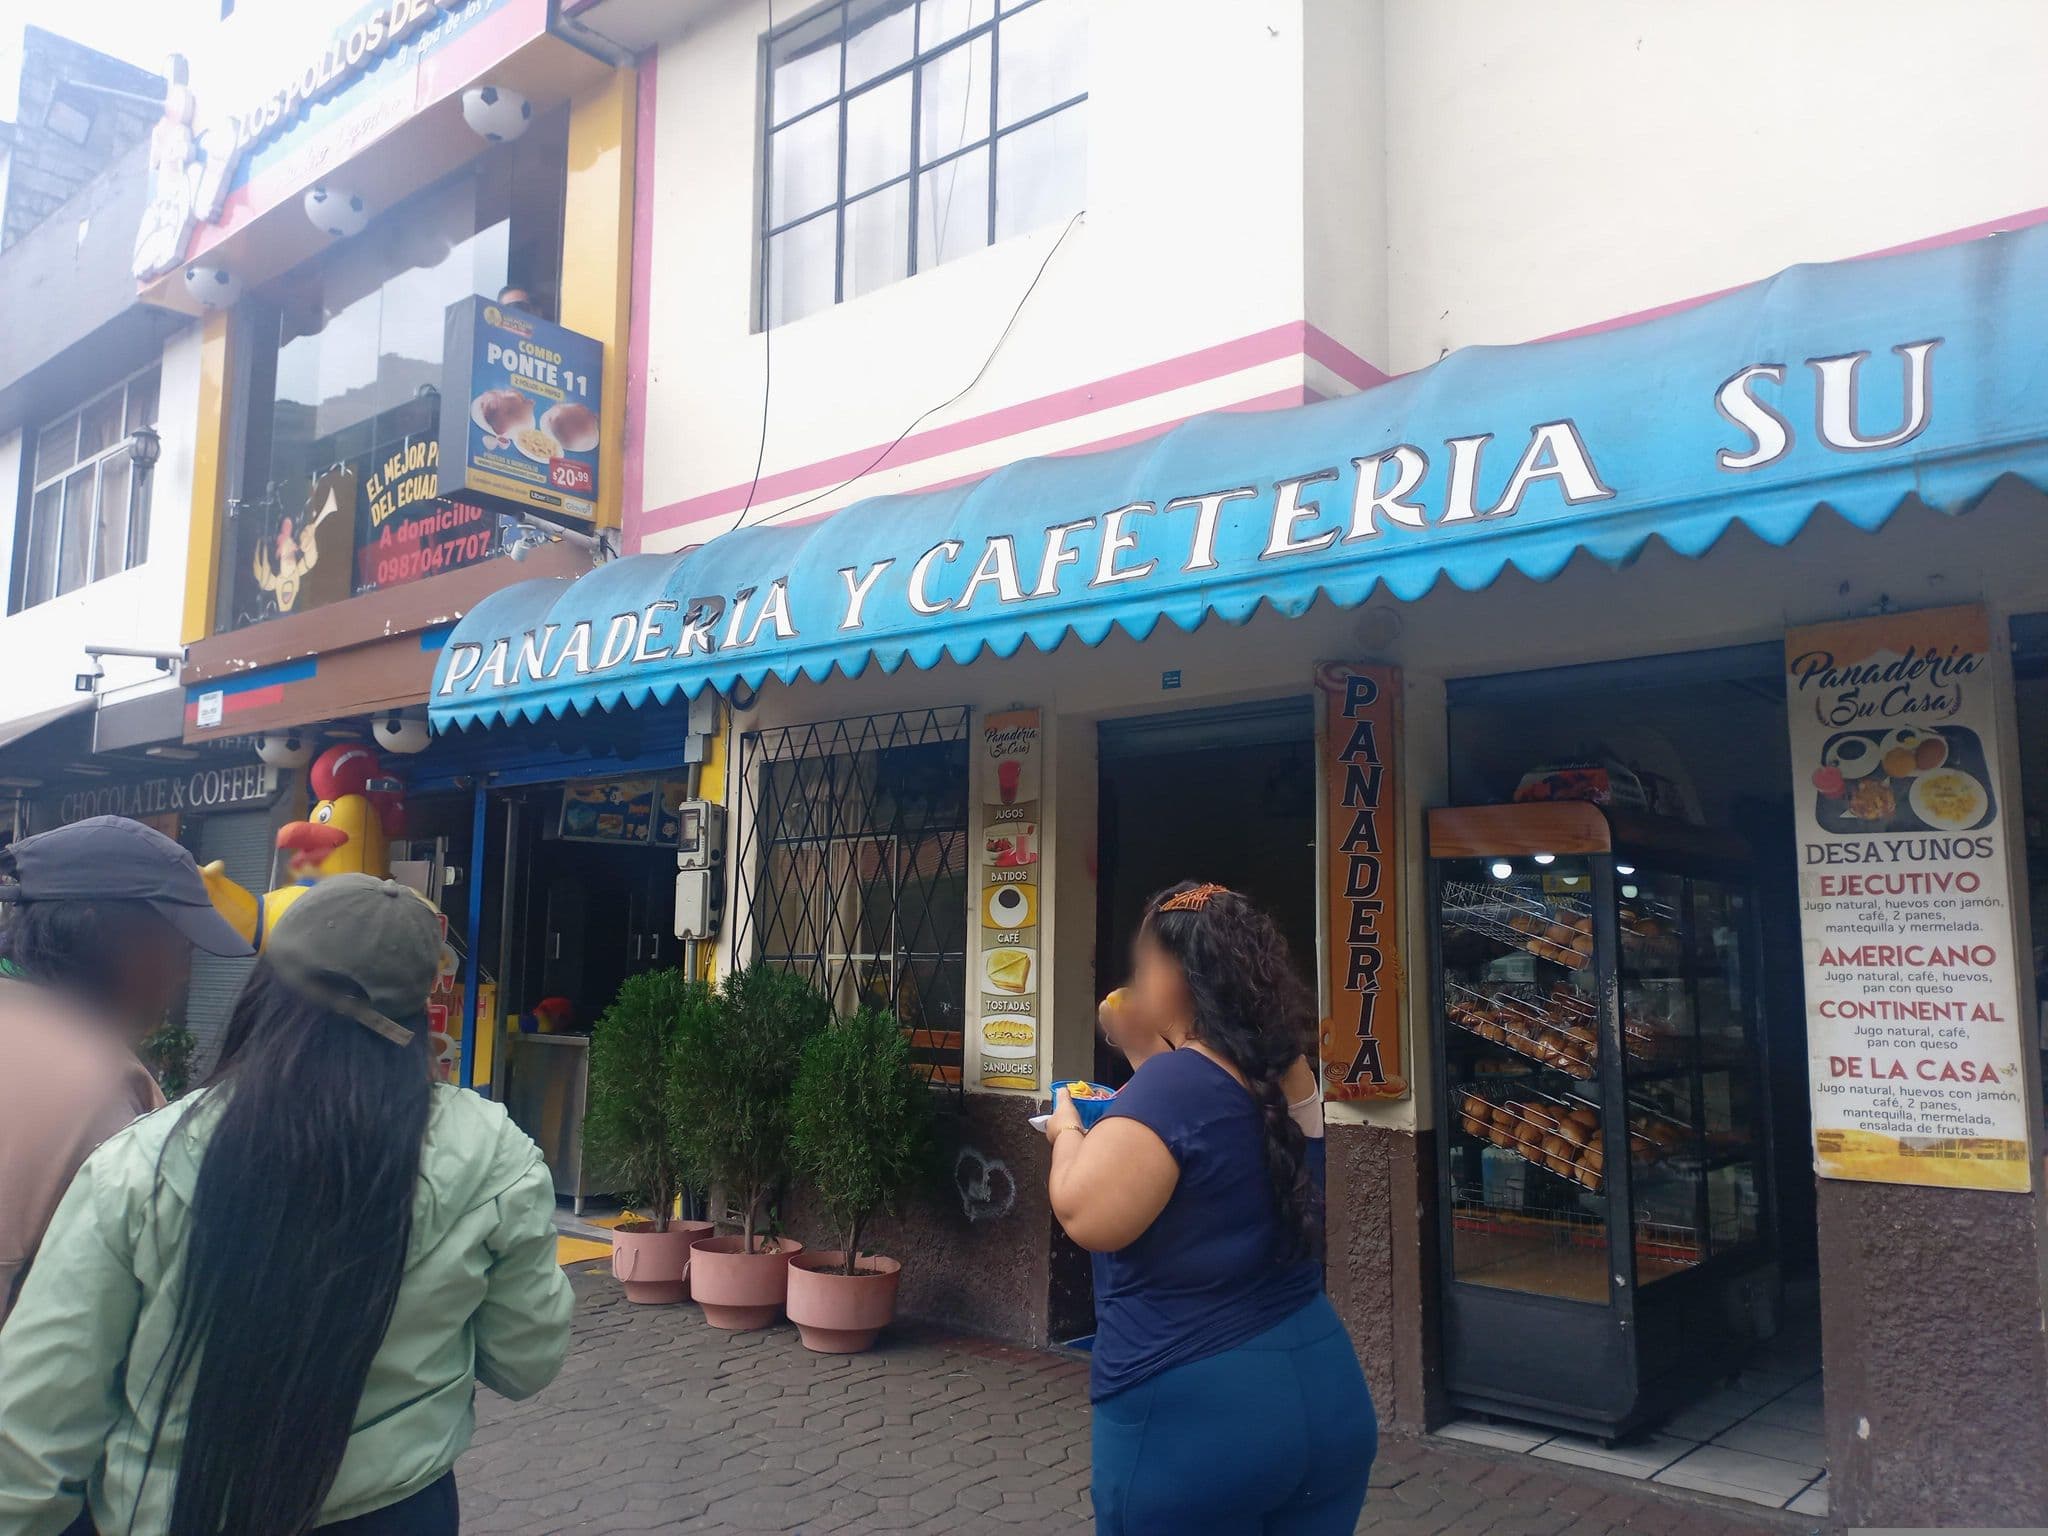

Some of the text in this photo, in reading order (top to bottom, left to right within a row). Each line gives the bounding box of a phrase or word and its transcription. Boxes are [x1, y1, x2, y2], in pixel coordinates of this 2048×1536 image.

[286, 8, 385, 112] POLLOS
[518, 340, 561, 365] COMBO
[487, 342, 587, 396] PONTE 11
[366, 473, 383, 502] EL
[384, 442, 426, 486] MEJOR
[552, 467, 589, 487] $20.99
[370, 491, 396, 527] DEL
[438, 337, 1946, 696] PANADERIA Y CAFETERIA SU
[380, 524, 392, 550] A
[377, 530, 491, 585] 0987047707
[1830, 682, 1954, 726] Su Casa
[61, 764, 267, 824] CHOCOLATE & COFFEE
[995, 808, 1024, 820] JUGOS
[1805, 836, 1994, 865] DESAYUNOS
[991, 871, 1027, 882] BATIDOS
[1338, 674, 1387, 1086] PANADERÍA
[1820, 871, 1981, 897] EJECUTIVO
[1804, 900, 1832, 913] Jugo
[1835, 899, 1881, 911] natural,
[1885, 898, 1929, 909] huevos
[1933, 899, 1956, 909] con
[1825, 920, 1983, 934] mantequilla y mermelada.
[1858, 910, 1946, 924] café, 2 panes,
[997, 930, 1020, 943] CAFÉ
[1818, 944, 1997, 967] AMERICANO
[1824, 970, 1993, 983] Jugo natural, café, huevos,
[1863, 984, 1954, 995] pan con queso
[986, 1000, 1031, 1012] TOSTADAS
[1819, 1000, 2005, 1022] CONTINENTAL
[1854, 1025, 1970, 1039] Jugo natural, café,
[1867, 1039, 1959, 1050] pan con queso
[983, 1063, 1033, 1075] SANDUCHES
[1829, 1056, 2001, 1084] DE LA CASA
[1816, 1082, 2021, 1103] Jugo natural, huevos con jamón,
[1872, 1098, 1961, 1112] café, 2 panes,
[1843, 1109, 1995, 1127] mantequilla, mermelada,
[1859, 1121, 1913, 1133] ensalada
[1917, 1123, 1932, 1133] de
